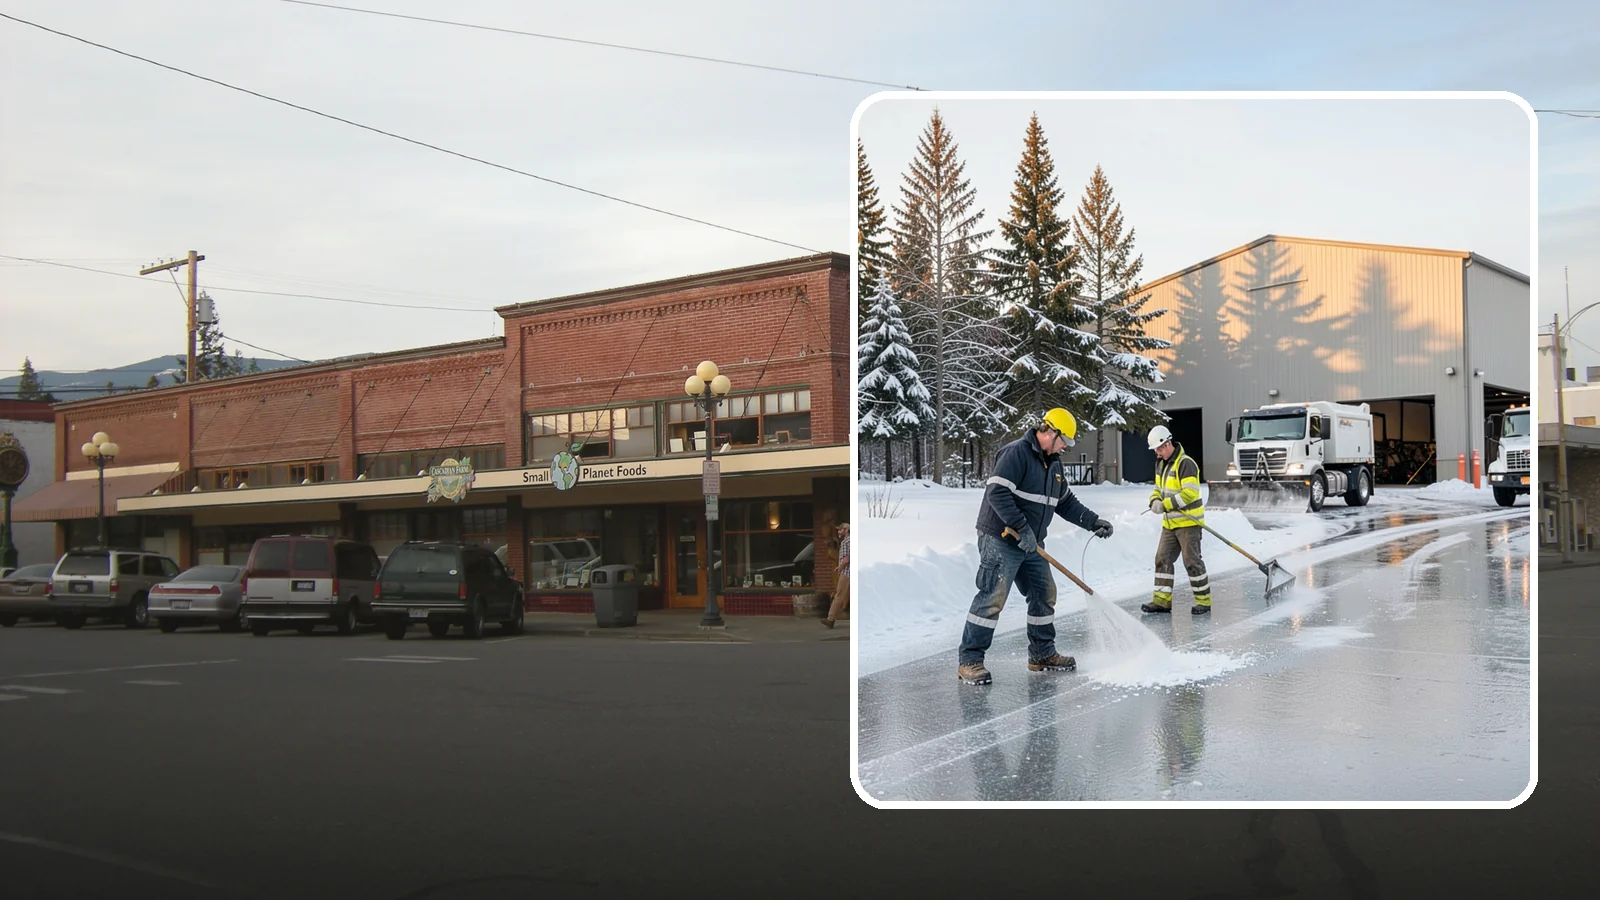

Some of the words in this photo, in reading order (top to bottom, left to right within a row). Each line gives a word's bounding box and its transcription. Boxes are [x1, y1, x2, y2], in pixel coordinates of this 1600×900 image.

[523, 471, 549, 483] Small
[583, 468, 614, 480] Planet
[617, 464, 647, 477] Foods
